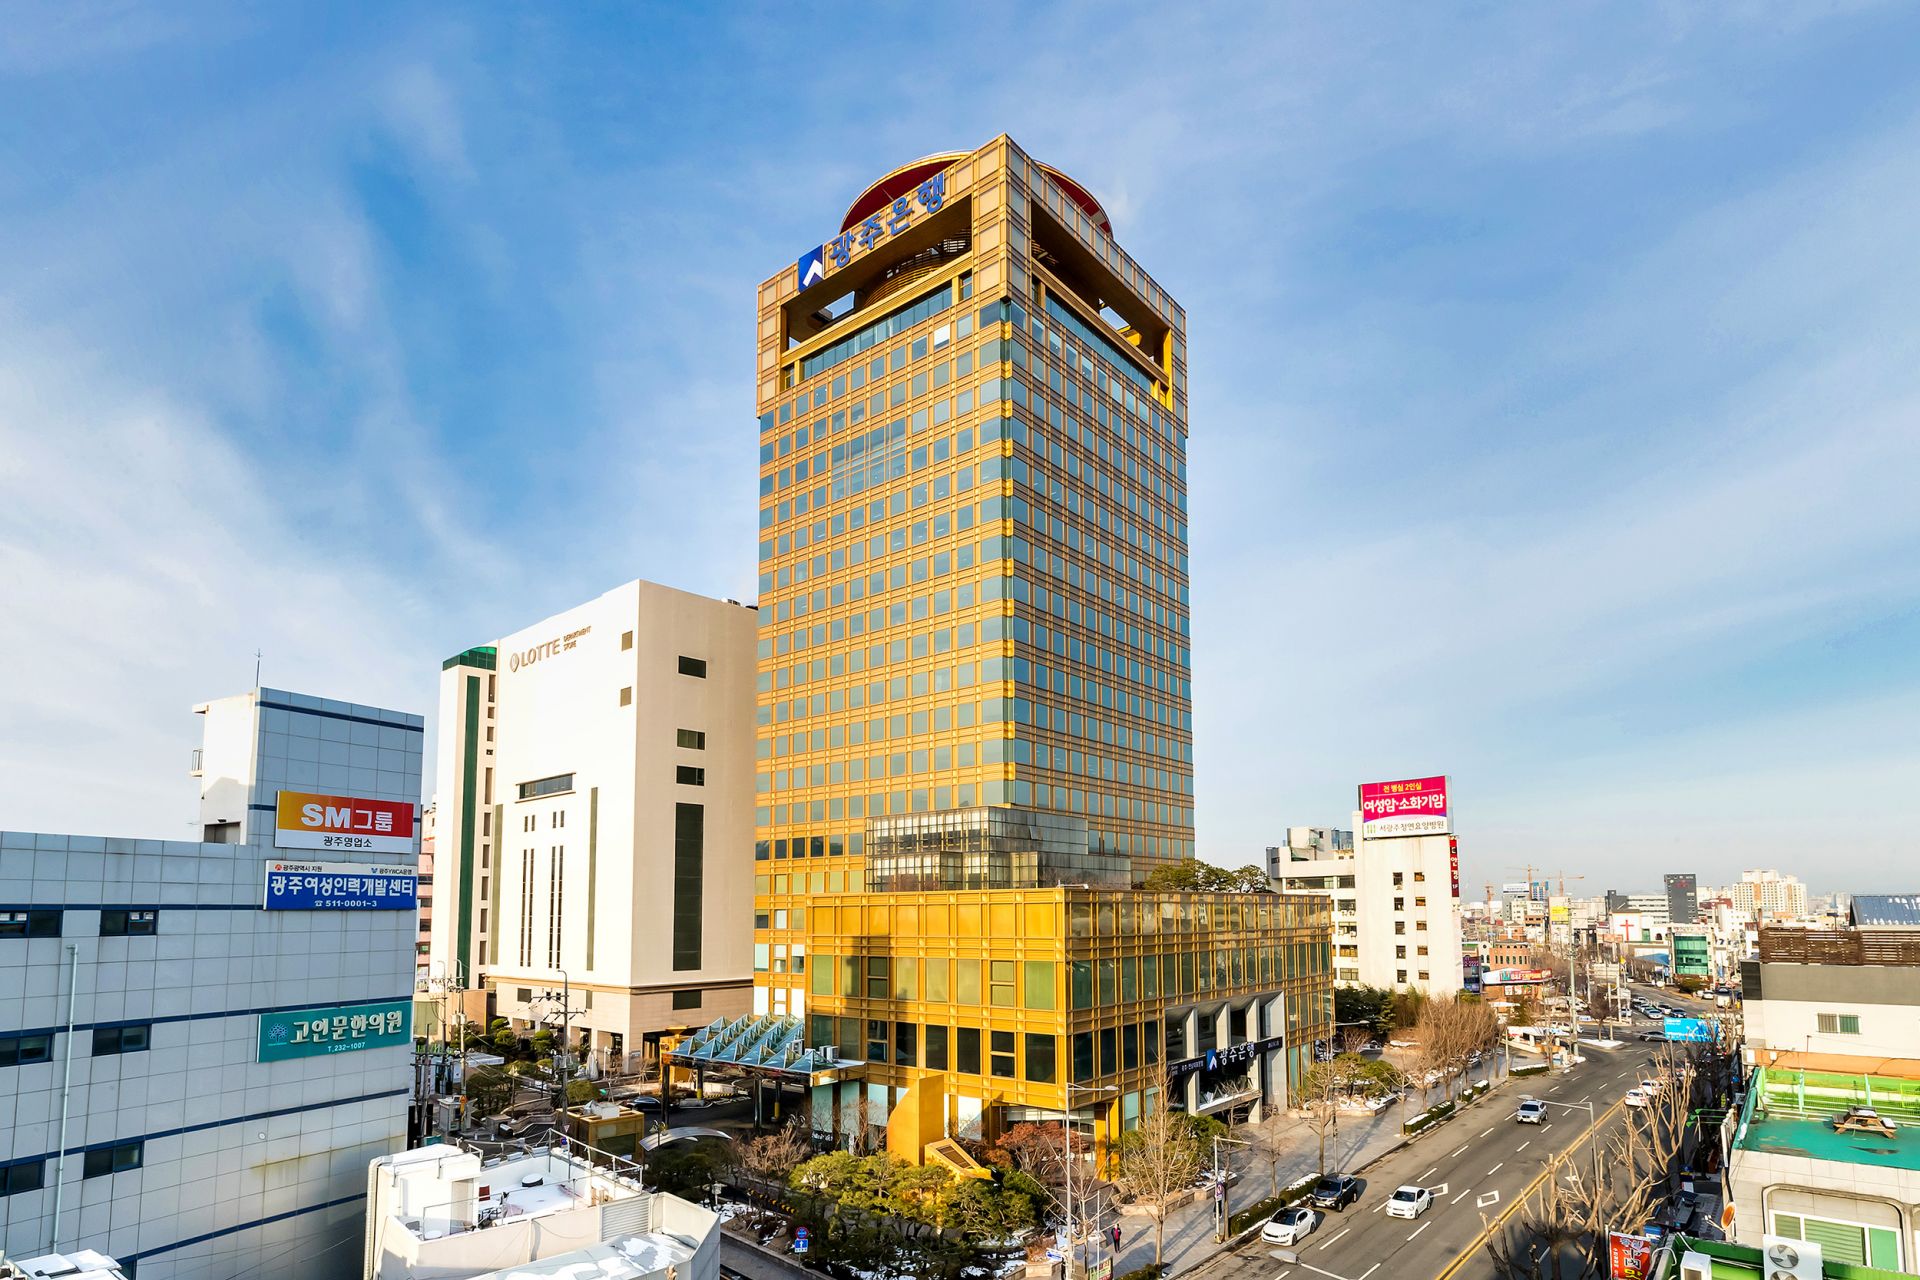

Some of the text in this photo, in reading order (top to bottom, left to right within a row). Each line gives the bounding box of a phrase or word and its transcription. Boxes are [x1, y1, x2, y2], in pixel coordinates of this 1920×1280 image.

[829, 172, 945, 268] 광주은행
[521, 638, 560, 667] LOTTE
[1364, 795, 1444, 814] 여성암·소화기암
[300, 802, 393, 832] SM그룹
[323, 836, 373, 848] 광주영업소
[312, 865, 323, 873] 지원
[290, 1010, 403, 1043] 고인문한의원
[328, 1042, 366, 1053] T.232-1007
[1219, 1041, 1255, 1065] 광주은행
